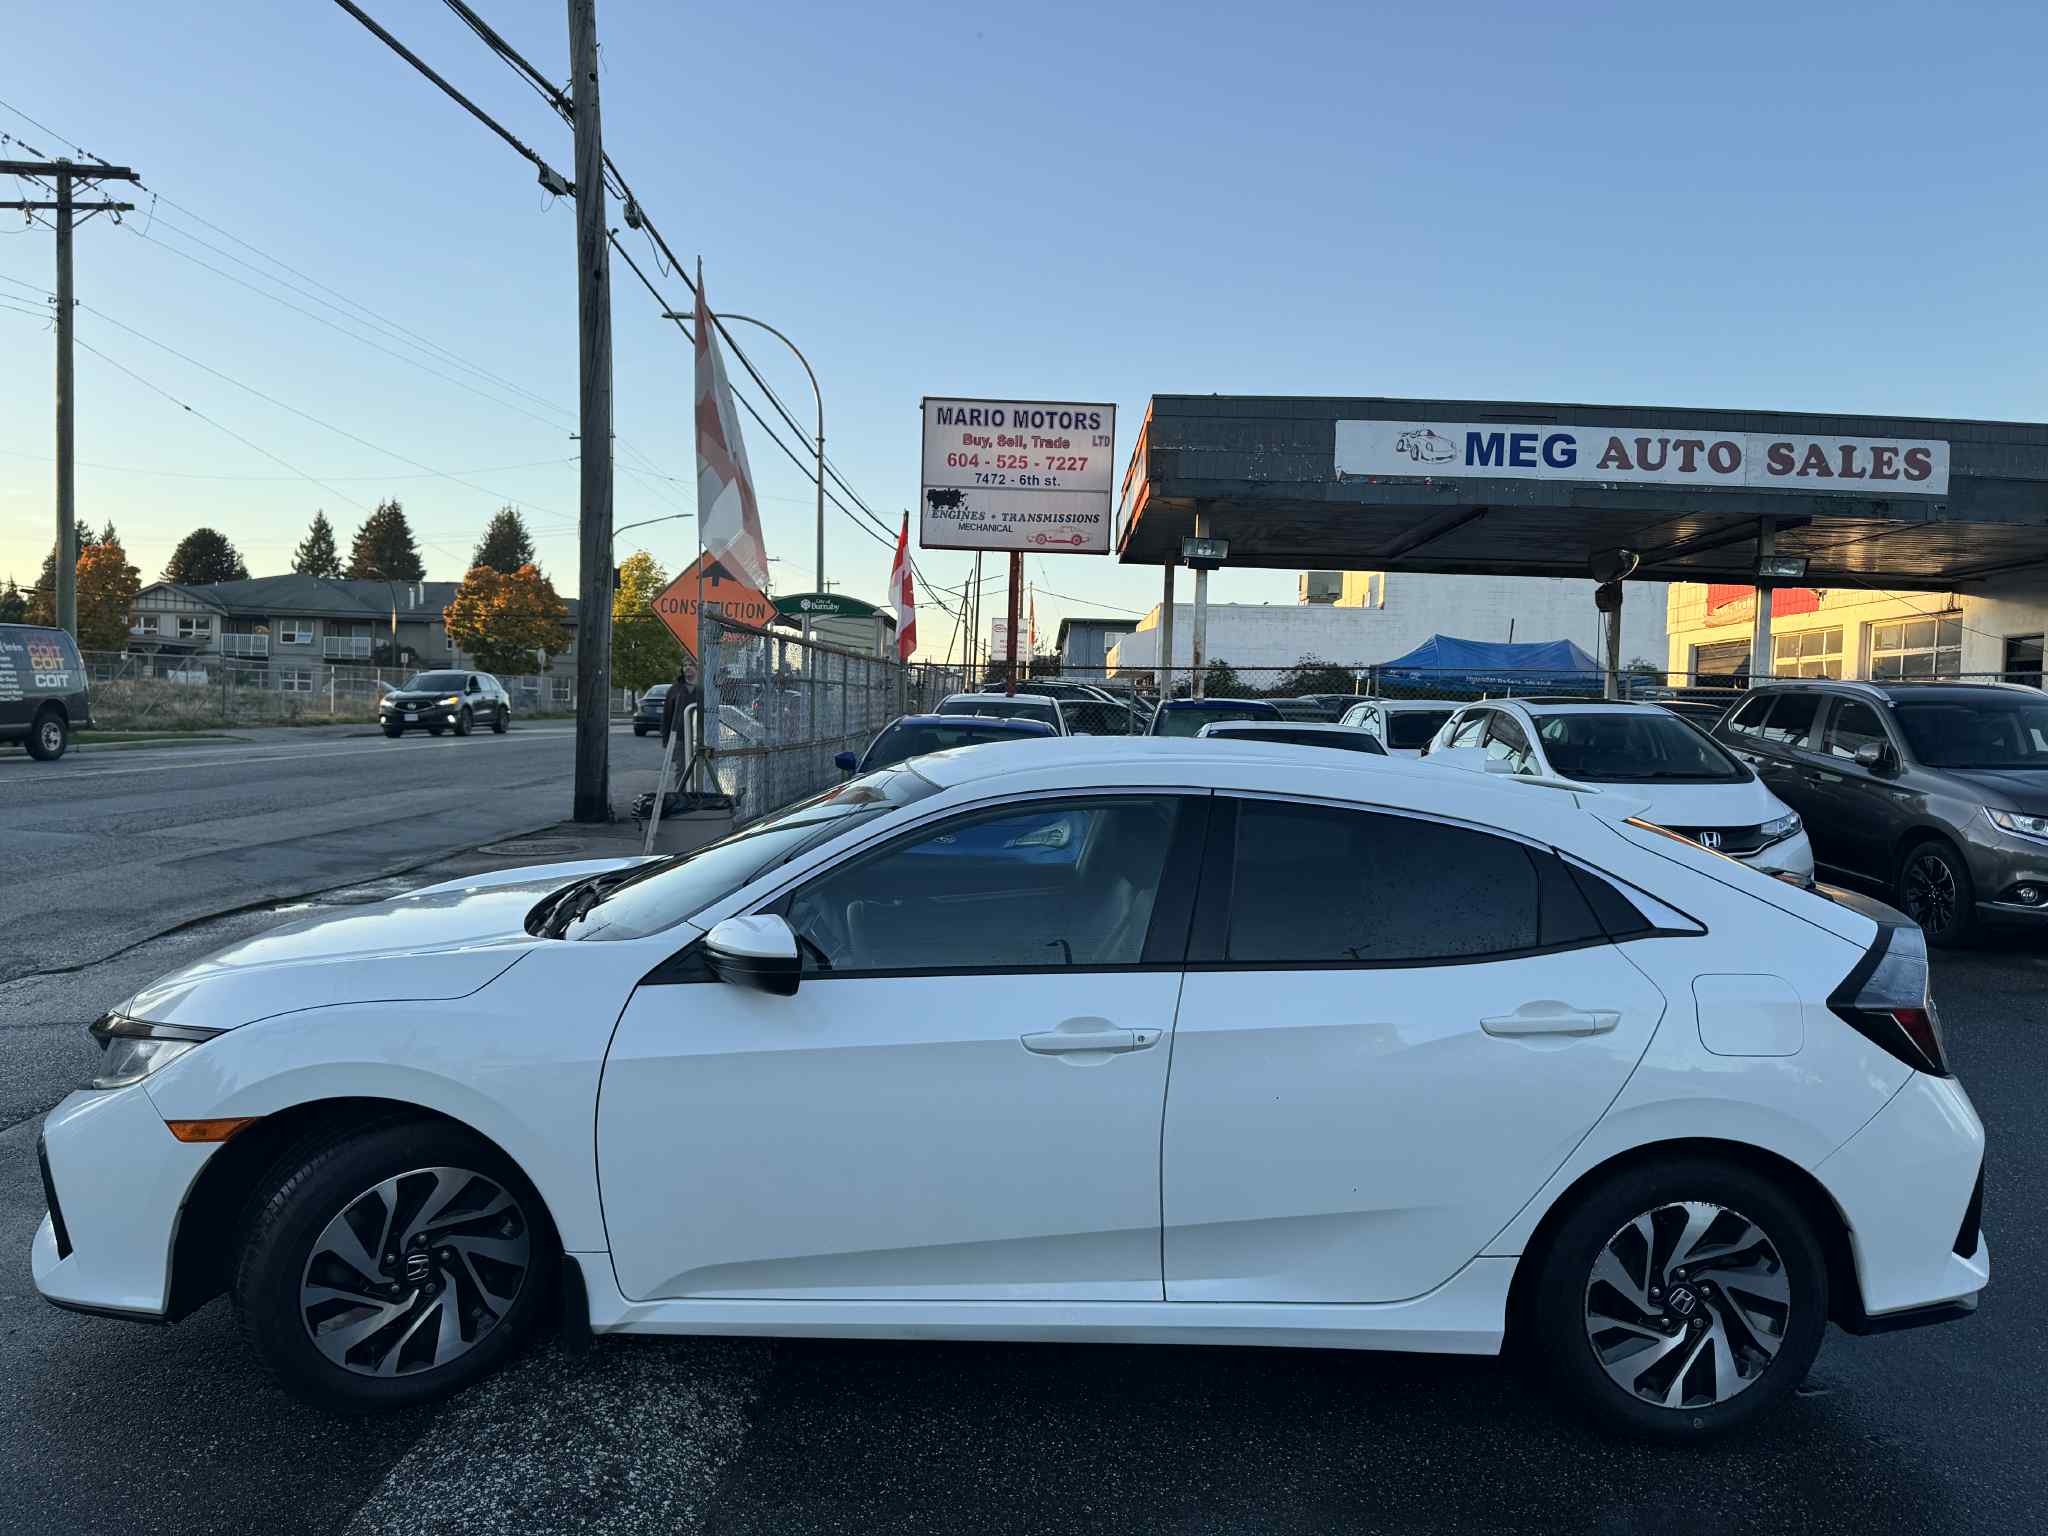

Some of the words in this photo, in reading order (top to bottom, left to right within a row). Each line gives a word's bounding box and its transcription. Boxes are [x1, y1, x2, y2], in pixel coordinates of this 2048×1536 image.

[937, 407, 1005, 427] MARIO
[1013, 410, 1101, 430] MOTORS
[962, 433, 993, 449] Buy,
[997, 434, 1028, 449] Sell,
[1031, 436, 1070, 449] Trade
[1092, 435, 1111, 447] LTD
[947, 453, 980, 467] 604
[996, 455, 1028, 469] 525
[1045, 457, 1088, 471] 7227
[1465, 432, 1577, 468] MEG
[1597, 436, 1742, 474] AUTO
[1767, 443, 1932, 482] SALES
[975, 473, 1006, 485] 7472
[1019, 475, 1040, 486] 6th
[1044, 477, 1061, 487] st.
[931, 510, 985, 521] ENGINES
[1001, 513, 1100, 523] TRANSMISSIONS
[958, 523, 1013, 533] MECHANICAL
[661, 599, 765, 619] CONSCTION
[32, 656, 64, 669] COIT
[35, 674, 69, 687] COIT
